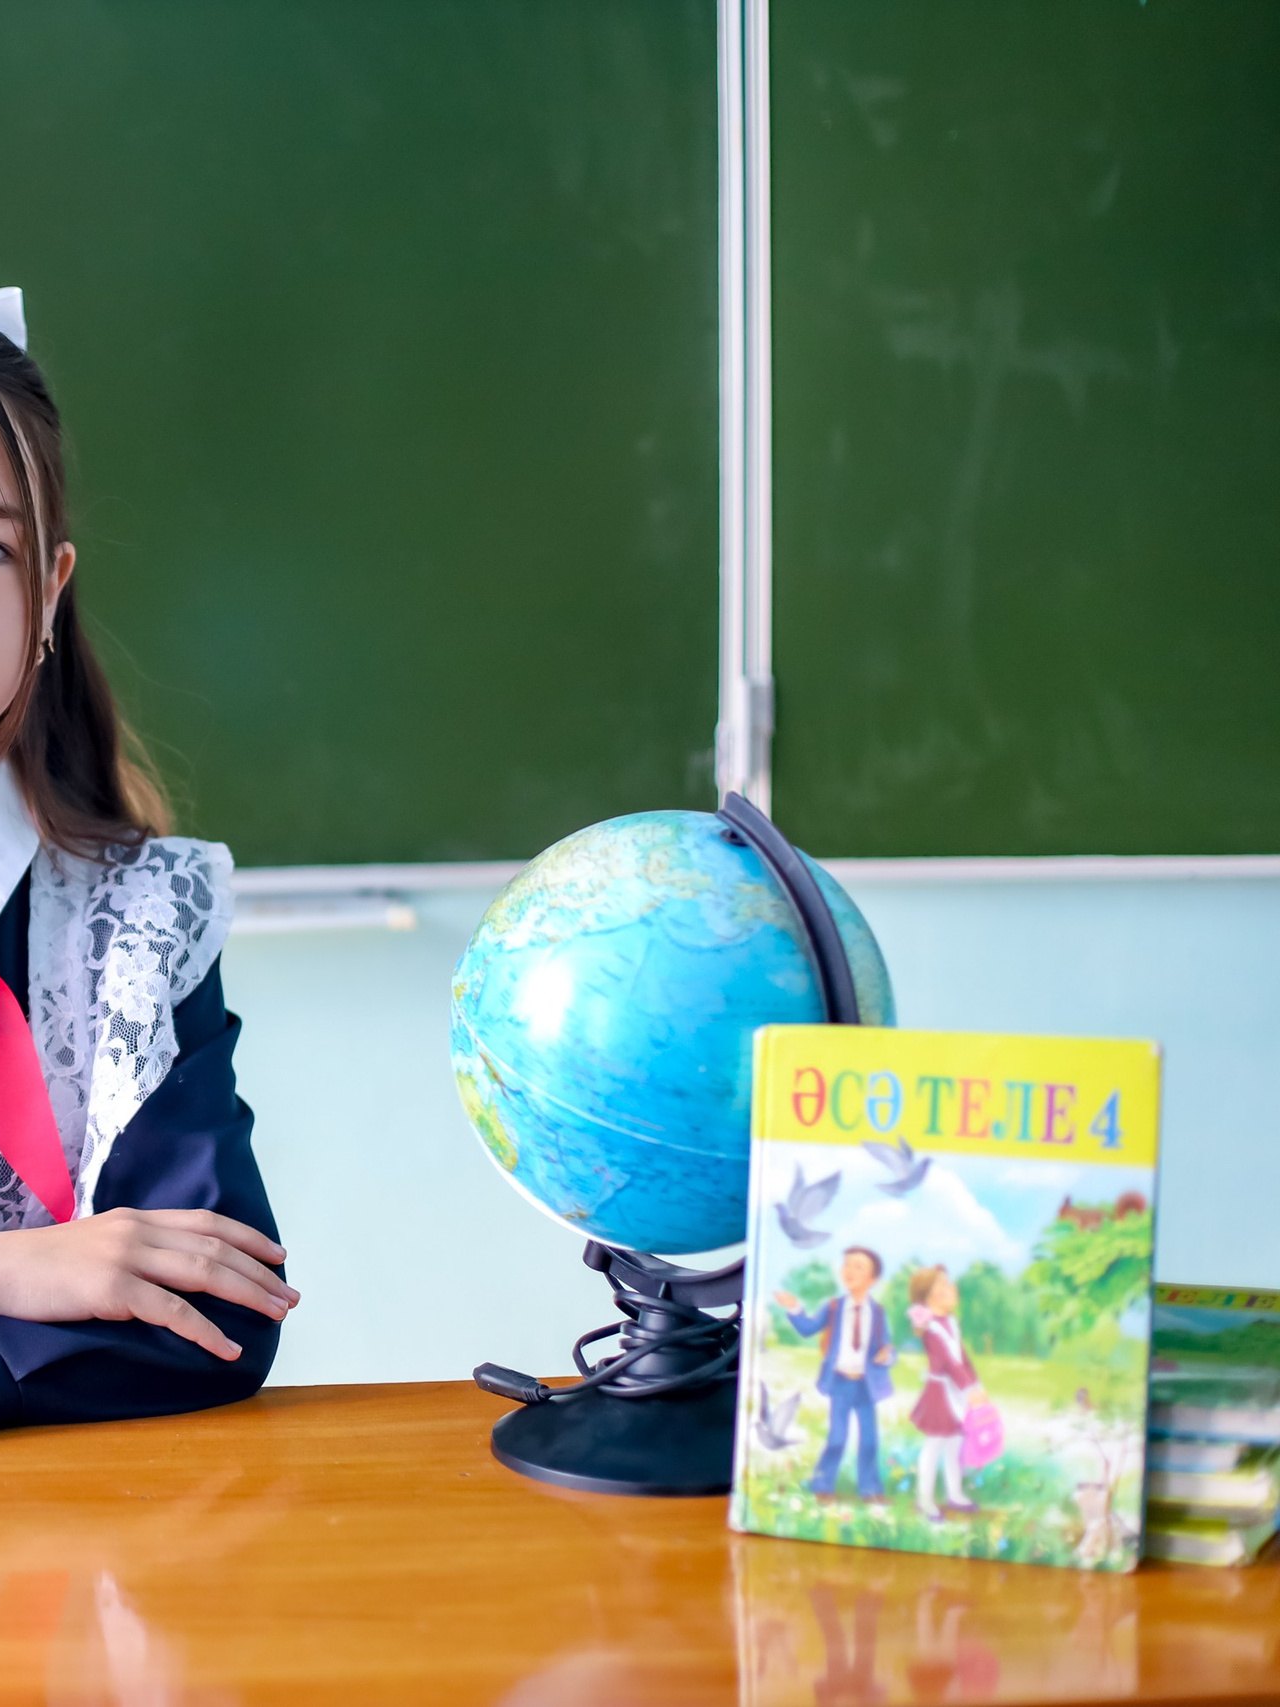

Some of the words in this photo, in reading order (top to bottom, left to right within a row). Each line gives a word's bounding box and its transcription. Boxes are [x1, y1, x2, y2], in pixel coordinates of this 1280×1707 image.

[792, 1067, 903, 1132] ӘСӘ
[916, 1075, 1076, 1144] ТЕЛЕ
[1089, 1088, 1123, 1149] 4
